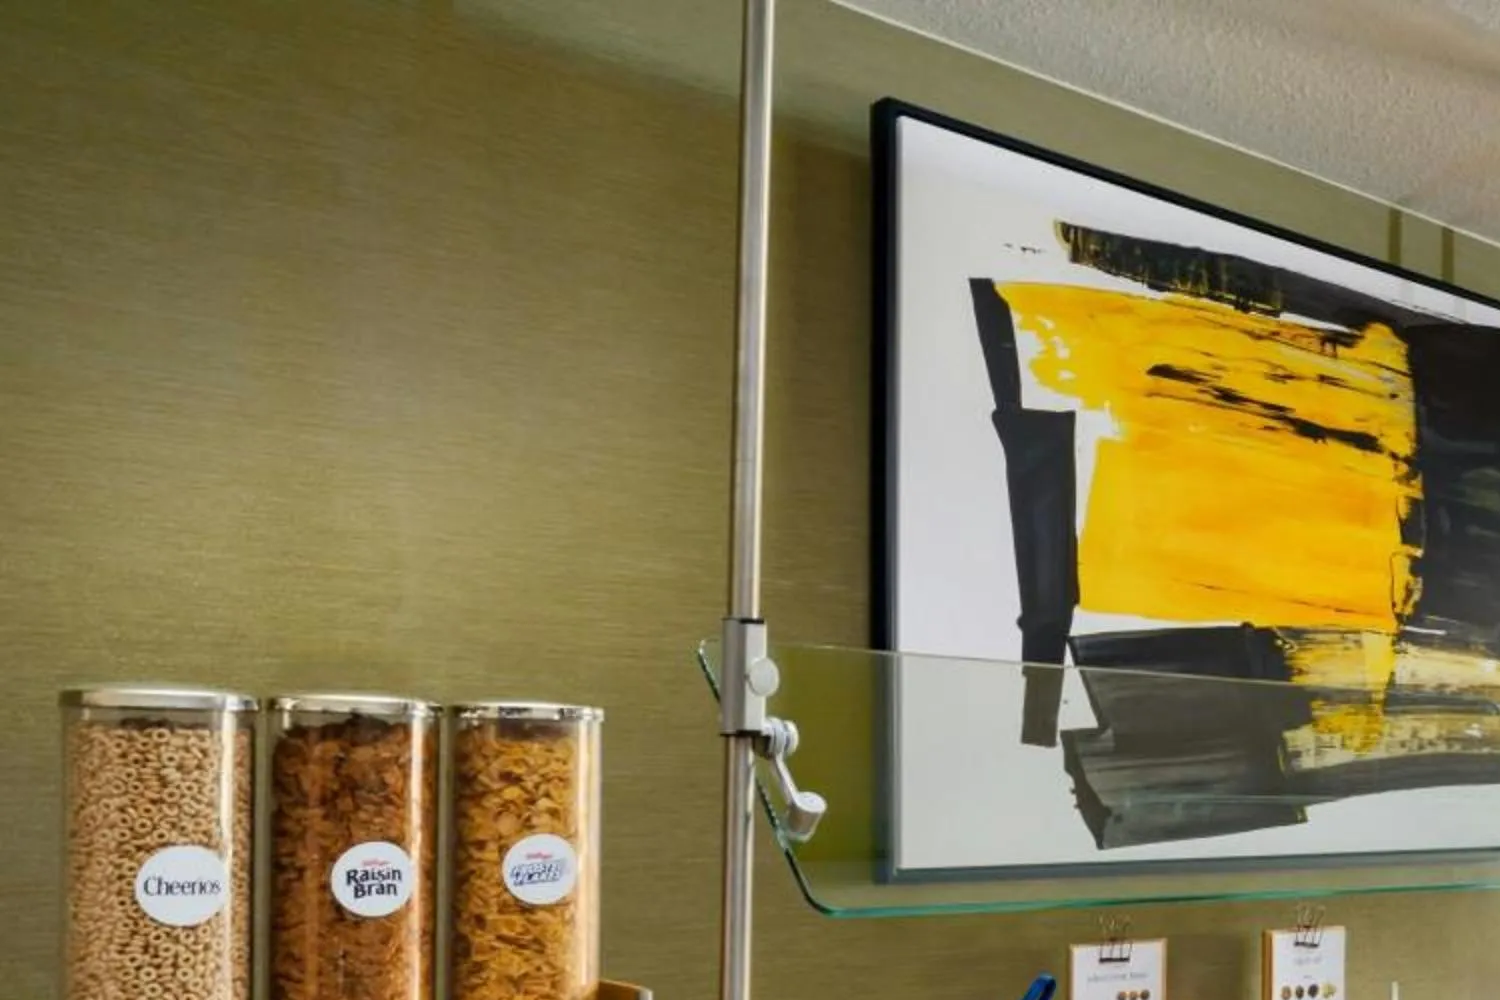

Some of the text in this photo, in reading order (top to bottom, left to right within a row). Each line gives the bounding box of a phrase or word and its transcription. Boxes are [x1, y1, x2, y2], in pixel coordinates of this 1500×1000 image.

[143, 875, 221, 896] Cheerios
[346, 869, 402, 886] Raisin
[353, 883, 398, 899] Bran
